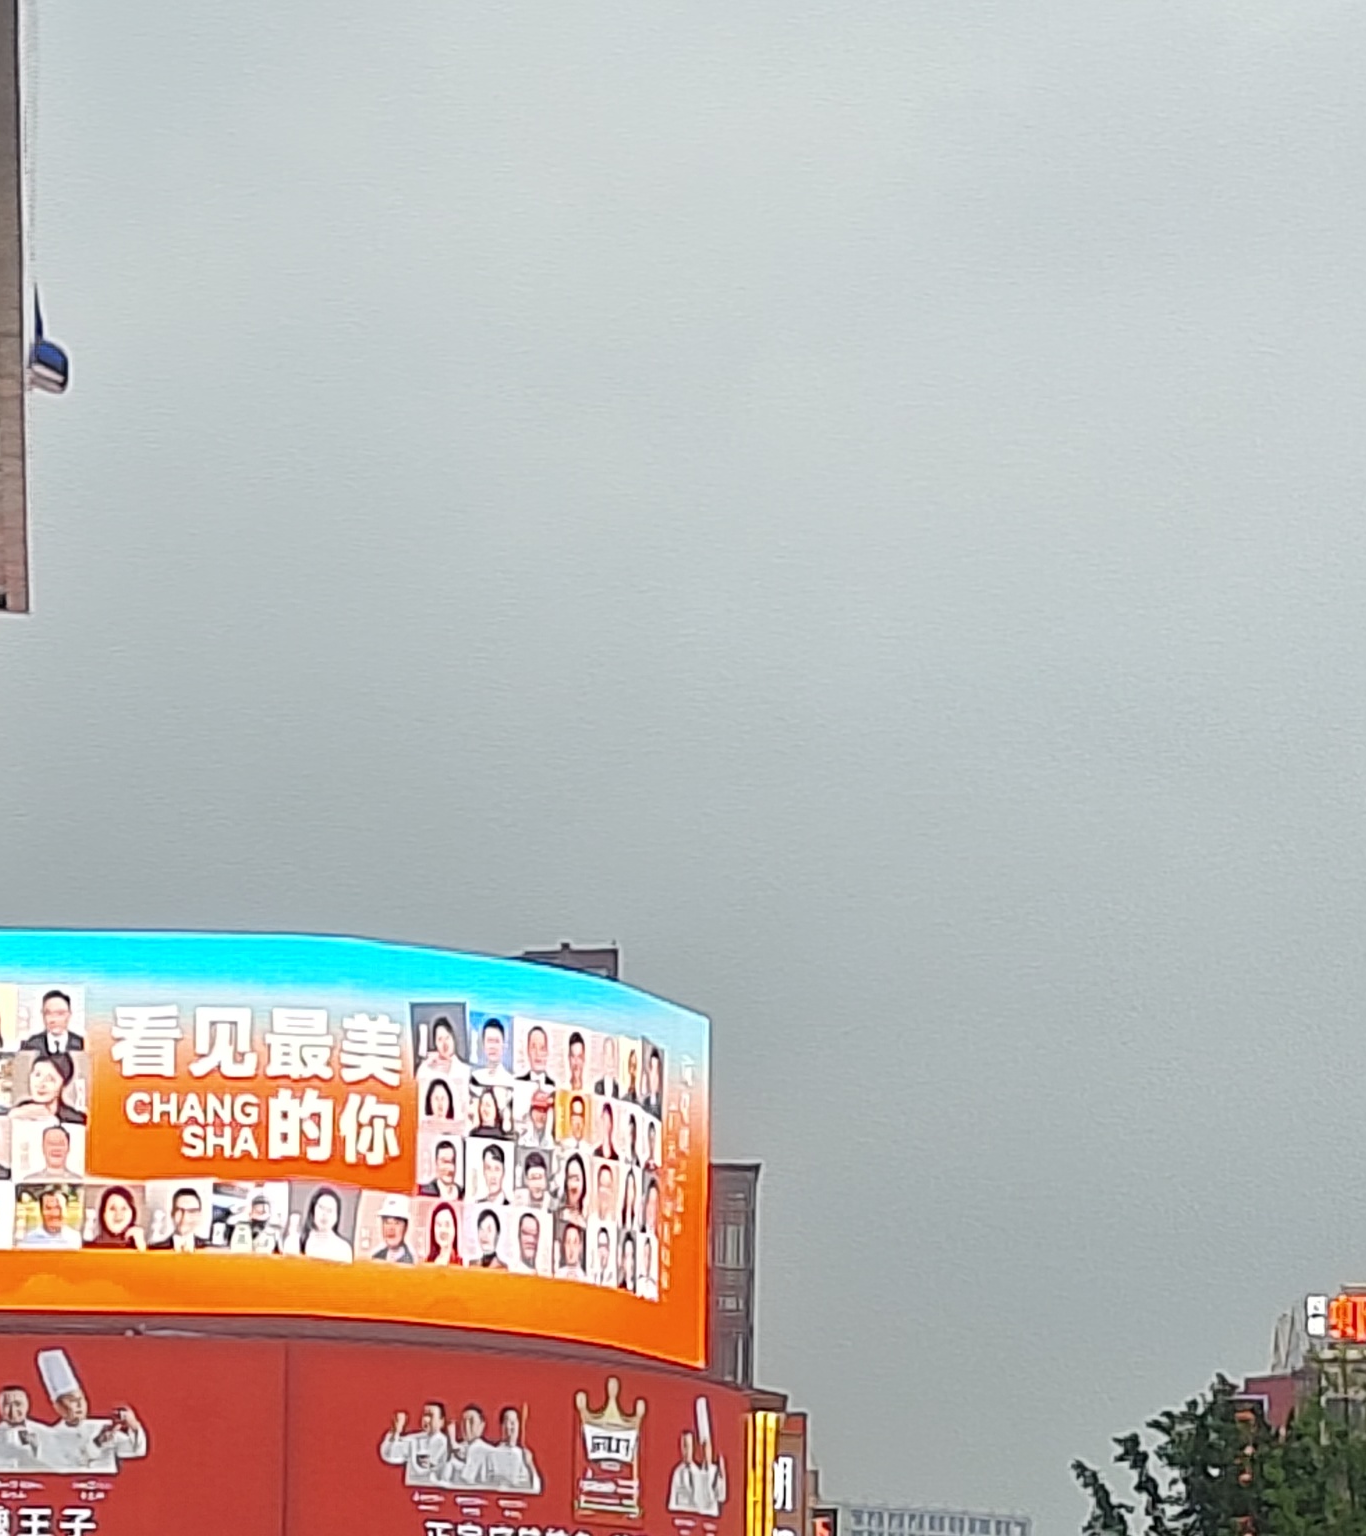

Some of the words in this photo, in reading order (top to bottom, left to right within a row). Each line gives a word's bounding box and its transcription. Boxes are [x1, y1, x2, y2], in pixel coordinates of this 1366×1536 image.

[111, 1004, 405, 1087] 看见最美
[125, 1092, 260, 1127] CHANG
[268, 1088, 402, 1167] 的你
[181, 1126, 260, 1160] SHA
